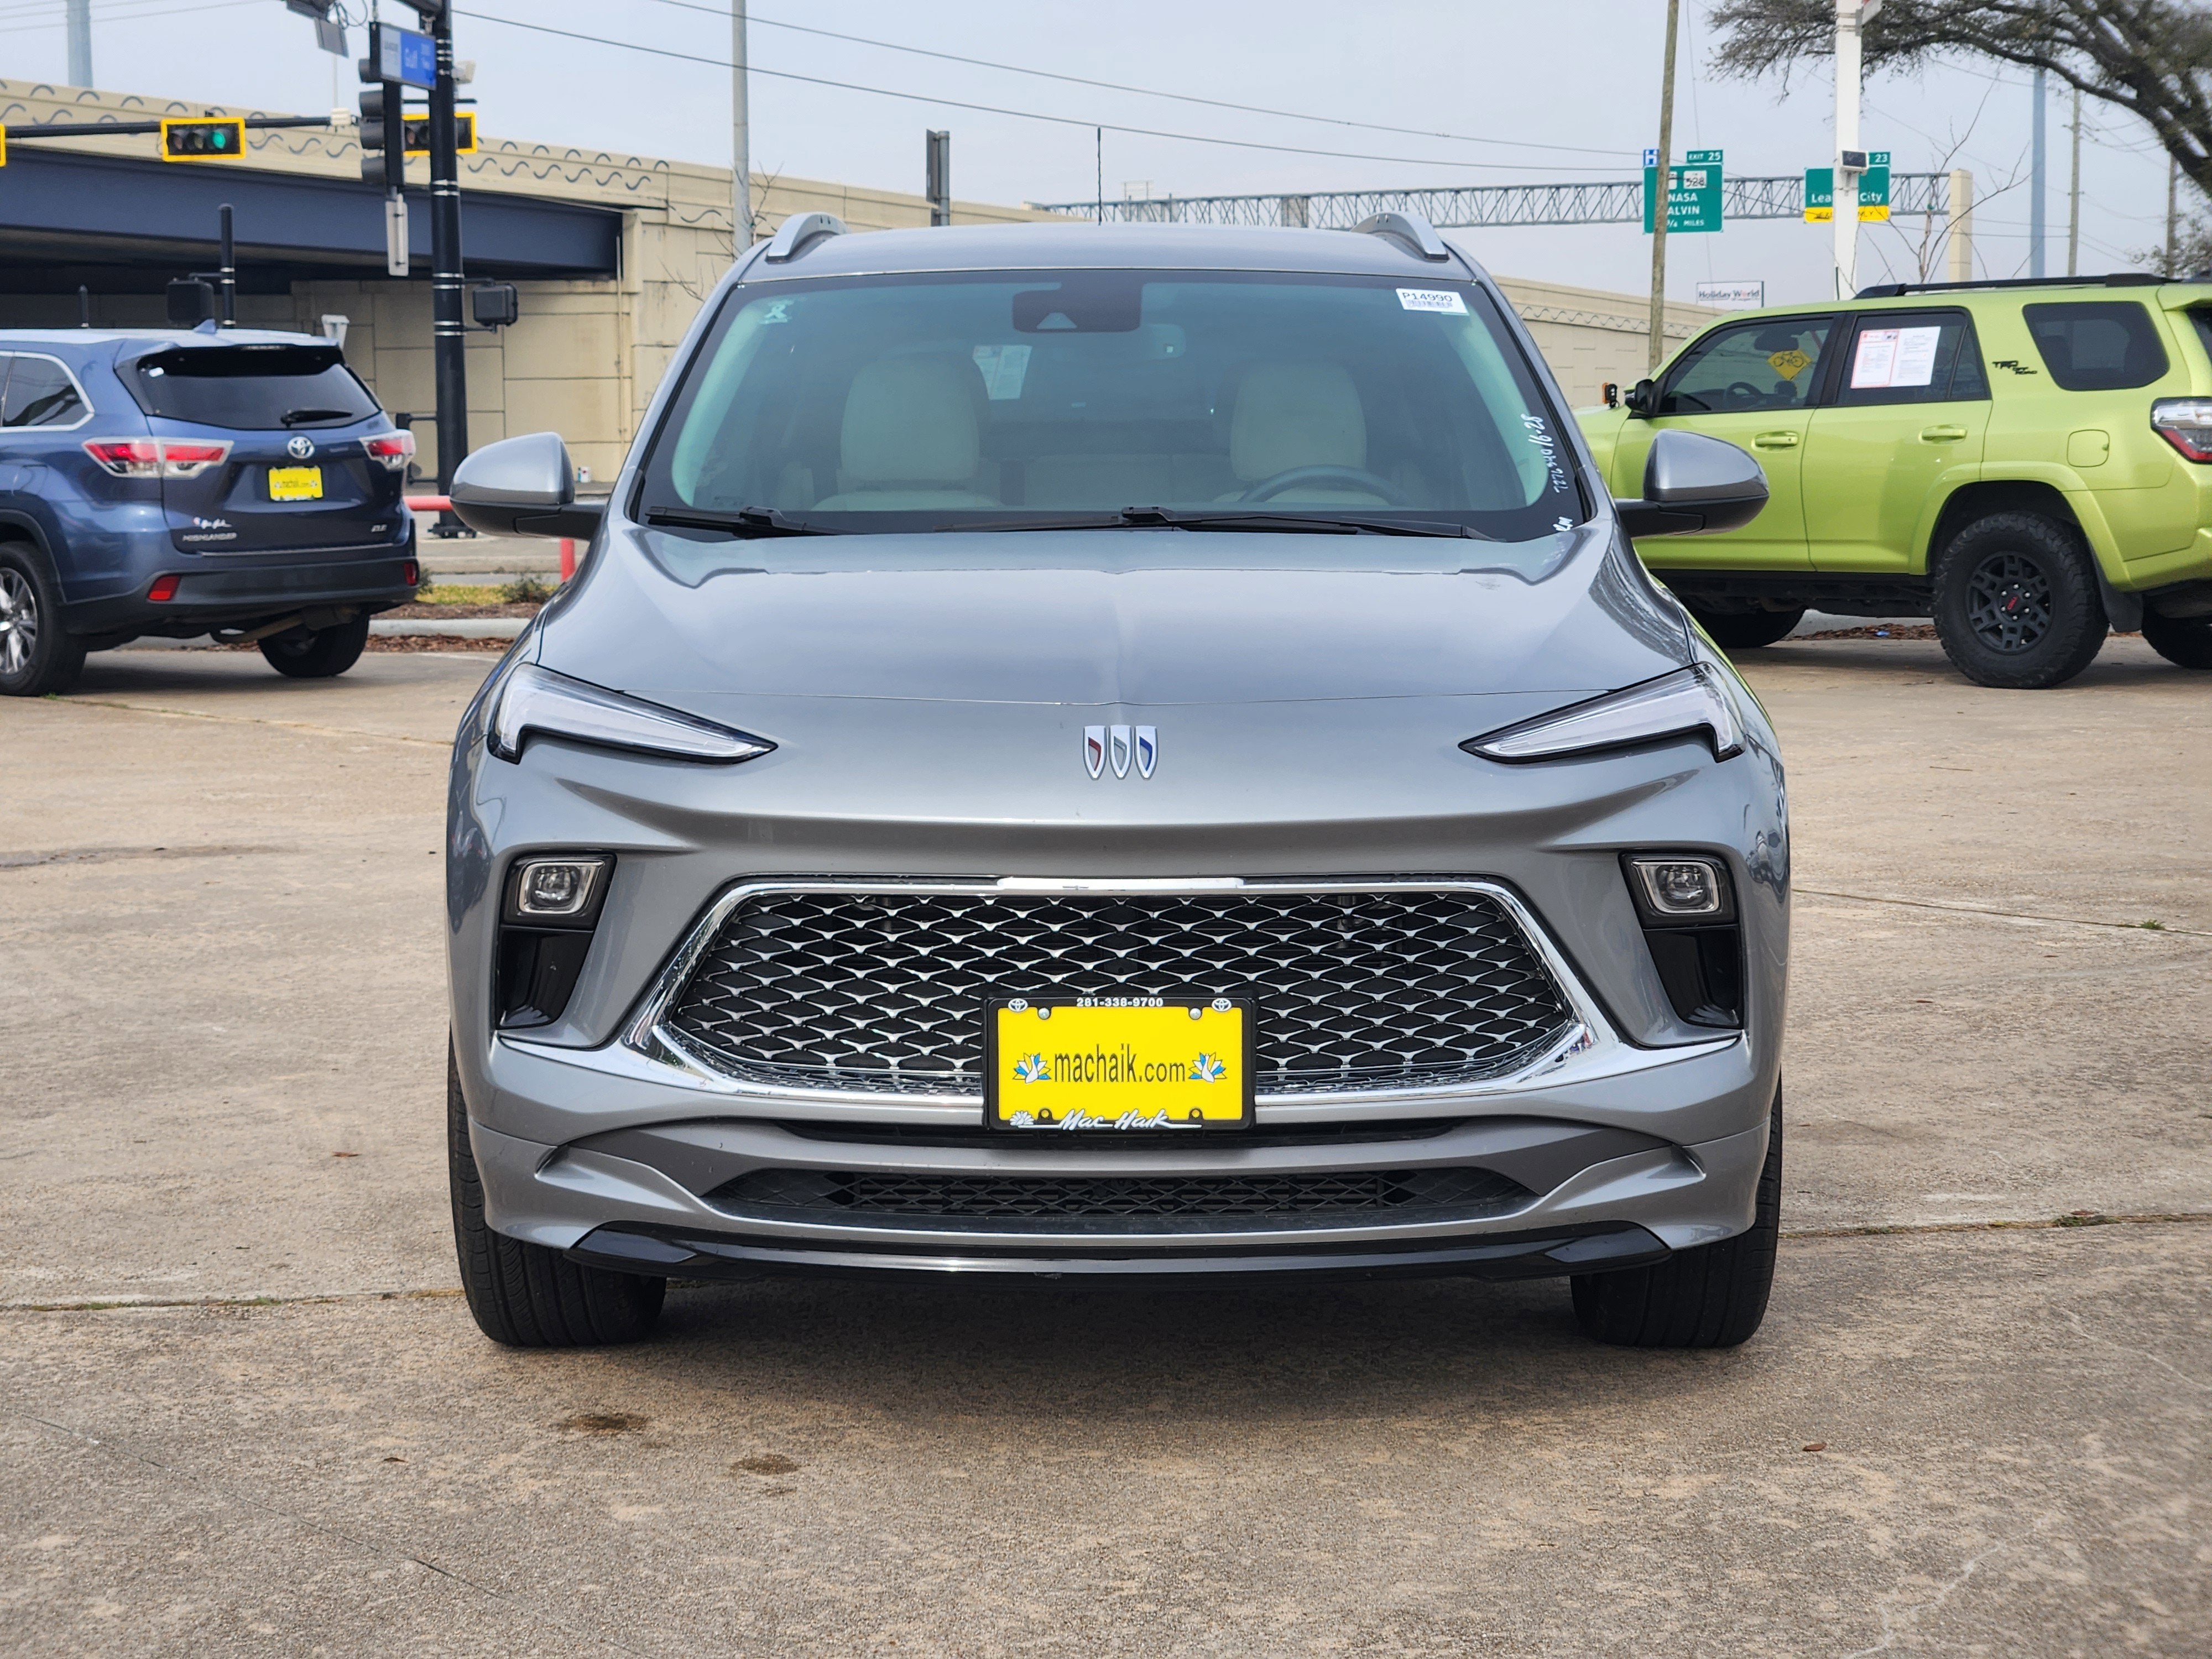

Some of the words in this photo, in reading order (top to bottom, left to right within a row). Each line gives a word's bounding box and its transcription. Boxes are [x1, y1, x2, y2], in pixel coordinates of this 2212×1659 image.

[1708, 152, 1721, 160] 25
[1875, 154, 1887, 163] 23
[1668, 193, 1698, 202] NASA
[1811, 194, 1832, 203] Lea
[1860, 191, 1882, 204] City
[1667, 206, 1700, 215] ALVIN
[1402, 293, 1452, 301] P14990
[1699, 291, 1730, 299] Holiday
[1076, 998, 1164, 1007] 281-338-9700
[1054, 1044, 1186, 1082] machaik.com
[1059, 1109, 1113, 1130] Mac
[1114, 1109, 1170, 1130] Haik
